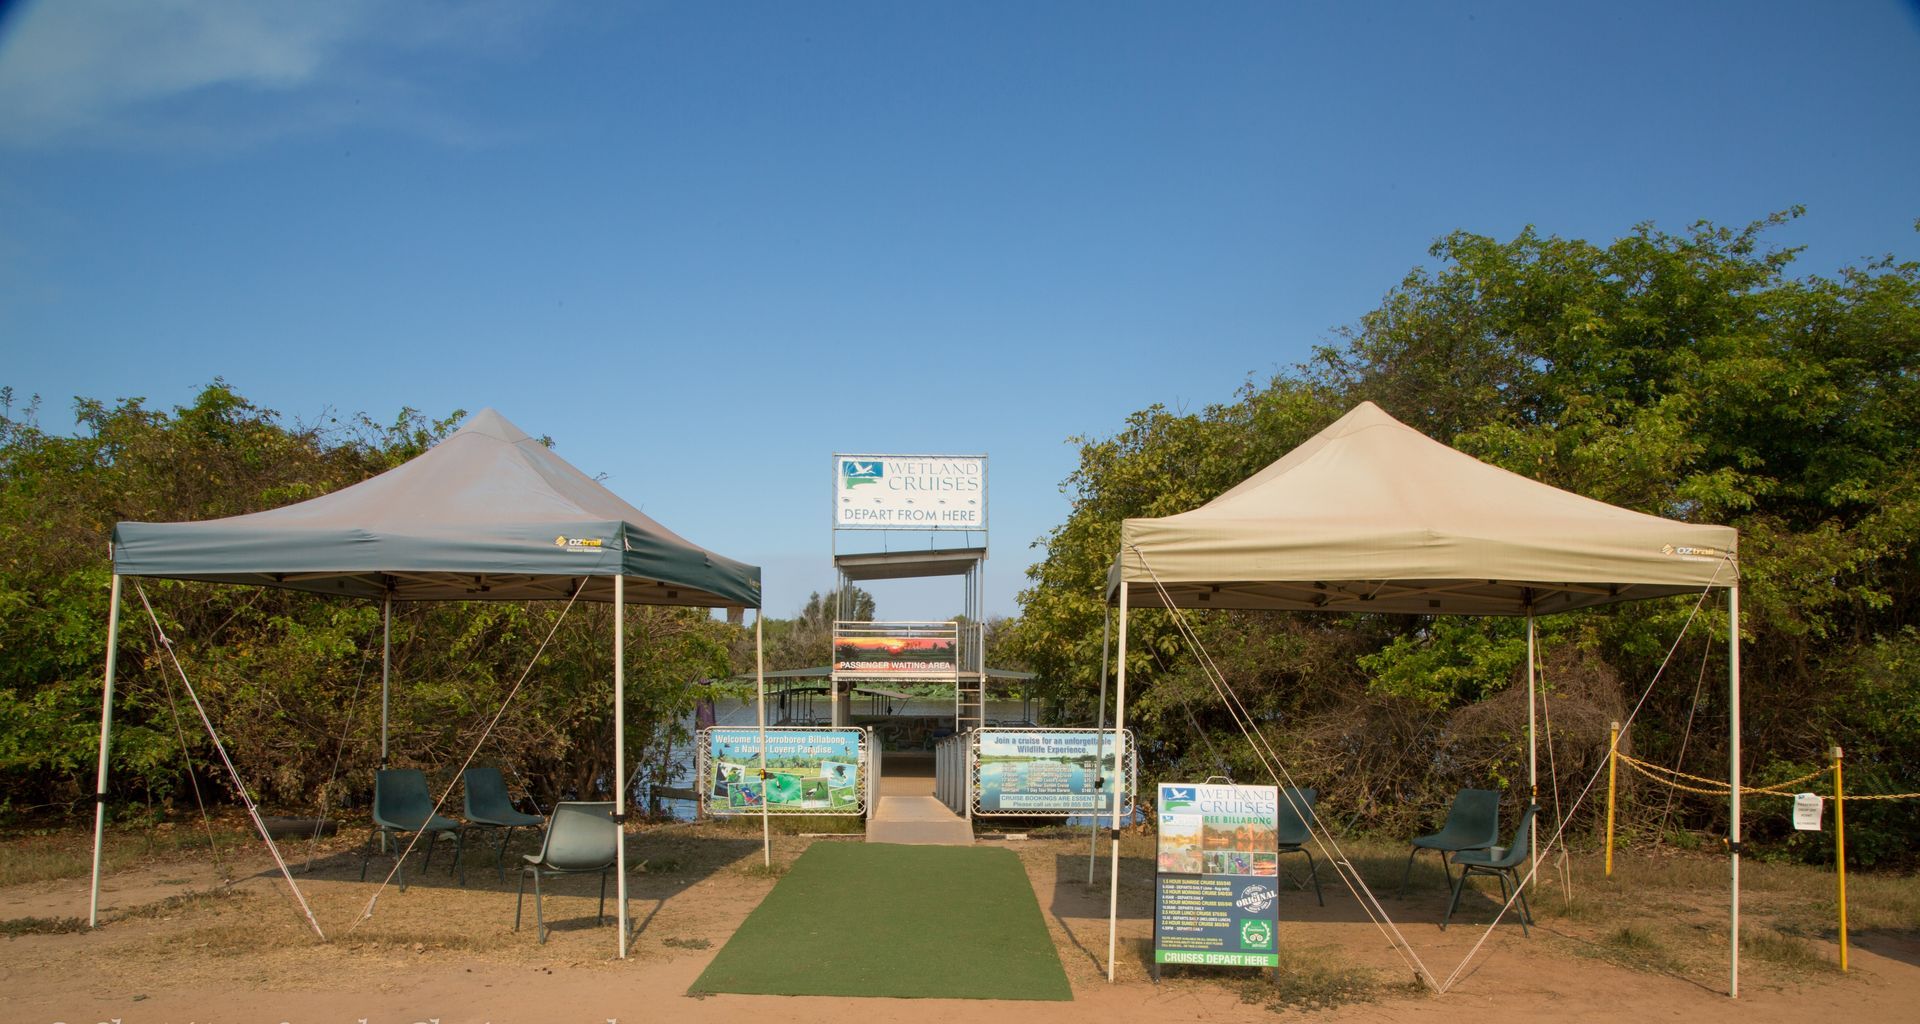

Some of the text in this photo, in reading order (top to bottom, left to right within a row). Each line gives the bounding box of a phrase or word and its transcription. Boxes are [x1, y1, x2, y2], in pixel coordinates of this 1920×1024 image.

[888, 462, 978, 475] WETLAND
[888, 476, 978, 490] CRUISES
[845, 508, 976, 522] DEPART FROM HERE
[716, 735, 750, 744] Welcome
[754, 736, 760, 744] to
[1200, 789, 1275, 800] WETLAND
[1200, 801, 1275, 814] CRUISES
[1202, 816, 1220, 824] REE
[1223, 816, 1272, 824] BILLABONG
[1236, 890, 1278, 908] ORIGINAL
[1164, 952, 1268, 965] CRUISES DEPART HERE
